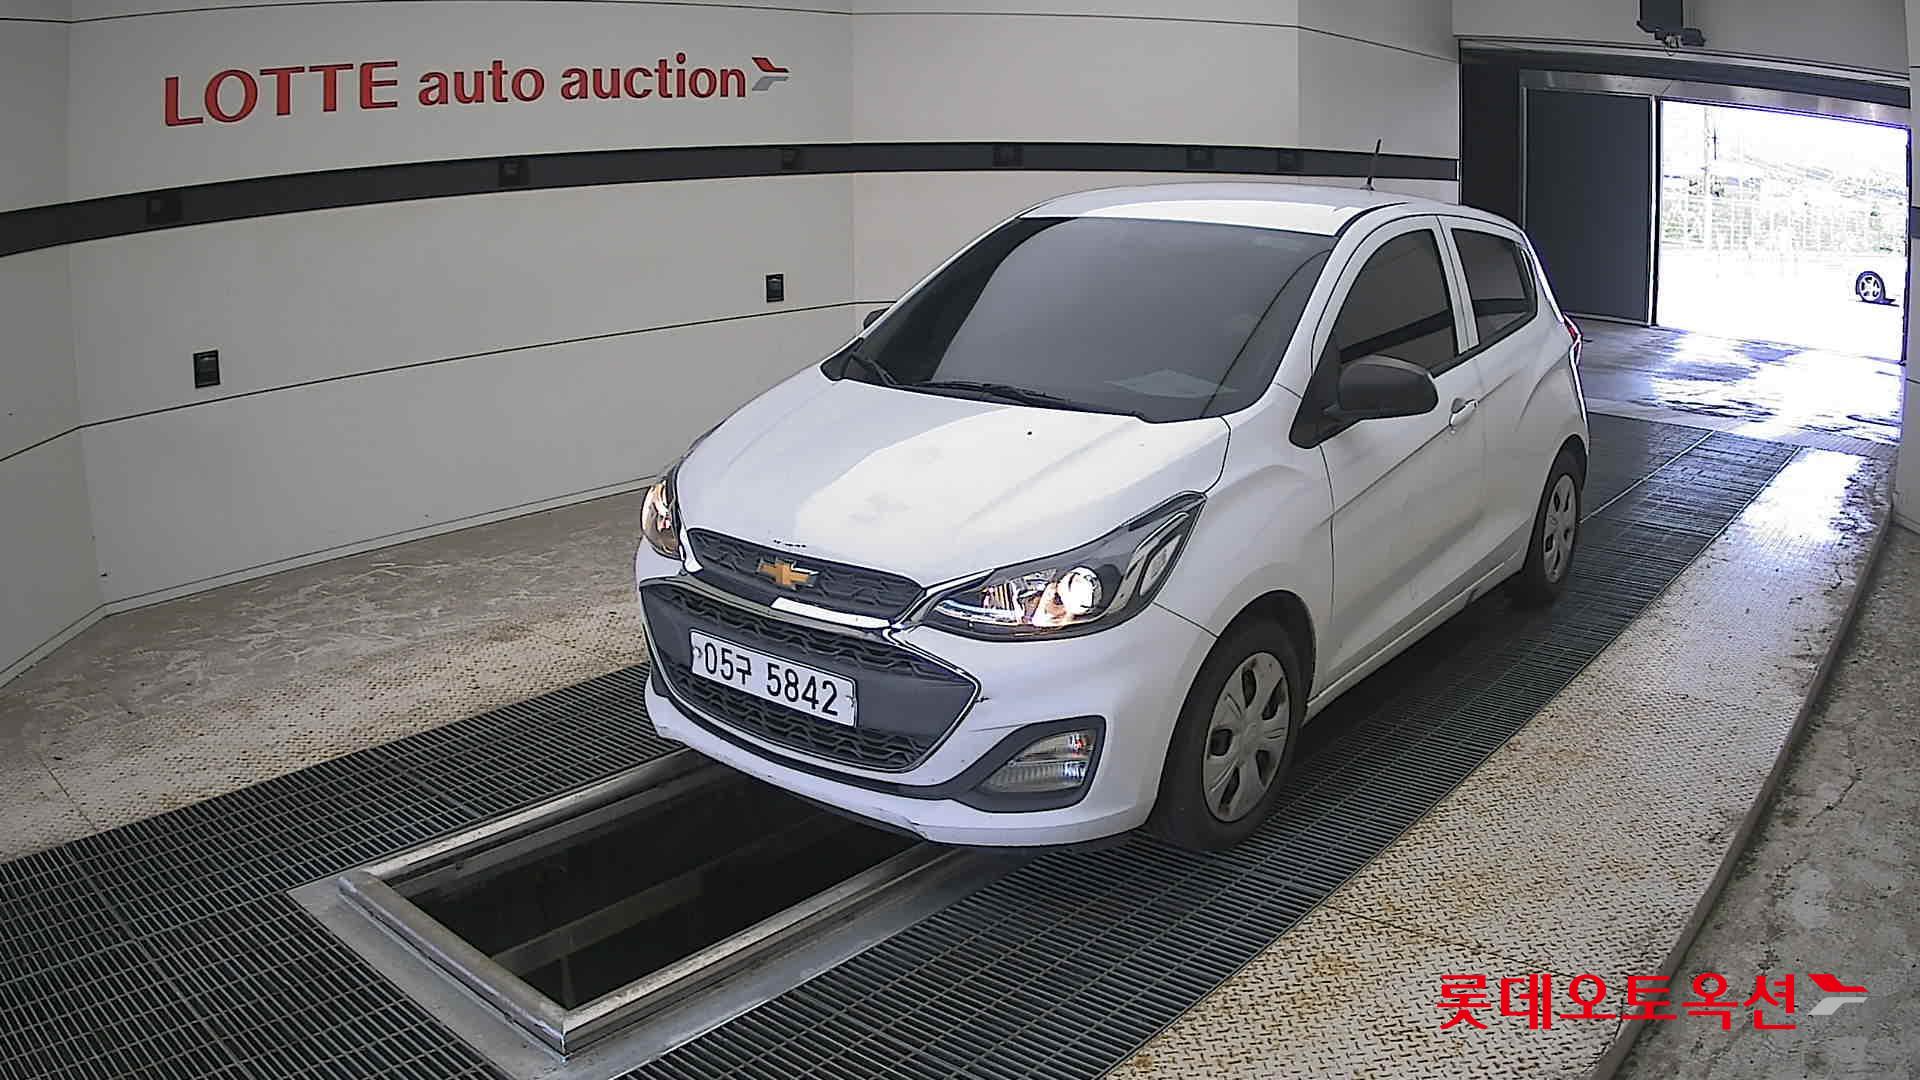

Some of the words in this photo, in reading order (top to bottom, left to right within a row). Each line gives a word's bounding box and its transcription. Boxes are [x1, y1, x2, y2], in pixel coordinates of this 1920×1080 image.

[164, 60, 399, 126] LOTTE
[417, 59, 545, 107] auto
[560, 52, 747, 100] auction
[704, 642, 752, 685] 05구
[766, 662, 838, 716] 5842
